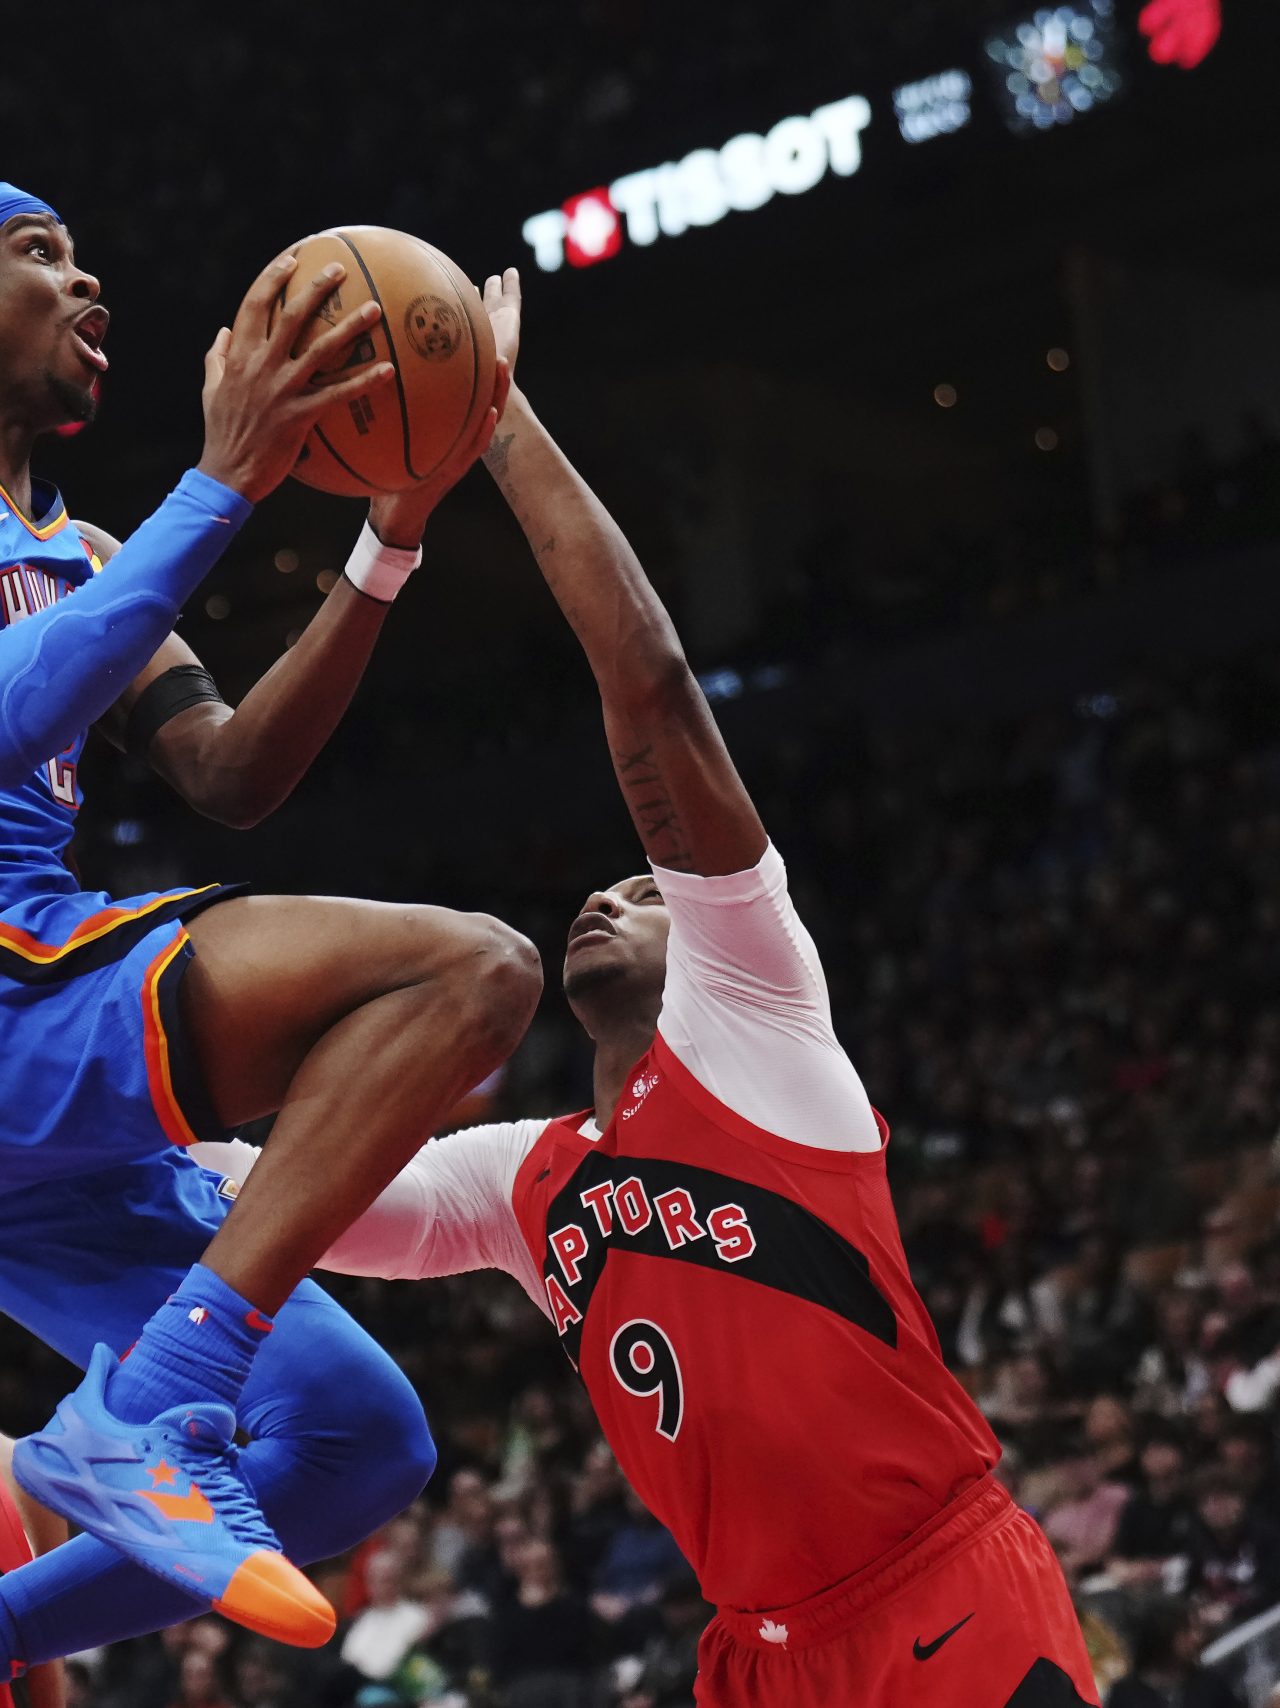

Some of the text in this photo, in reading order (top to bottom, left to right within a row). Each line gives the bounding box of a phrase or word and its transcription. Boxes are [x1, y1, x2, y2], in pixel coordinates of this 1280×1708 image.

[609, 94, 872, 247] TISSOT
[545, 1175, 757, 1337] APTORS
[609, 1318, 685, 1443] 9
